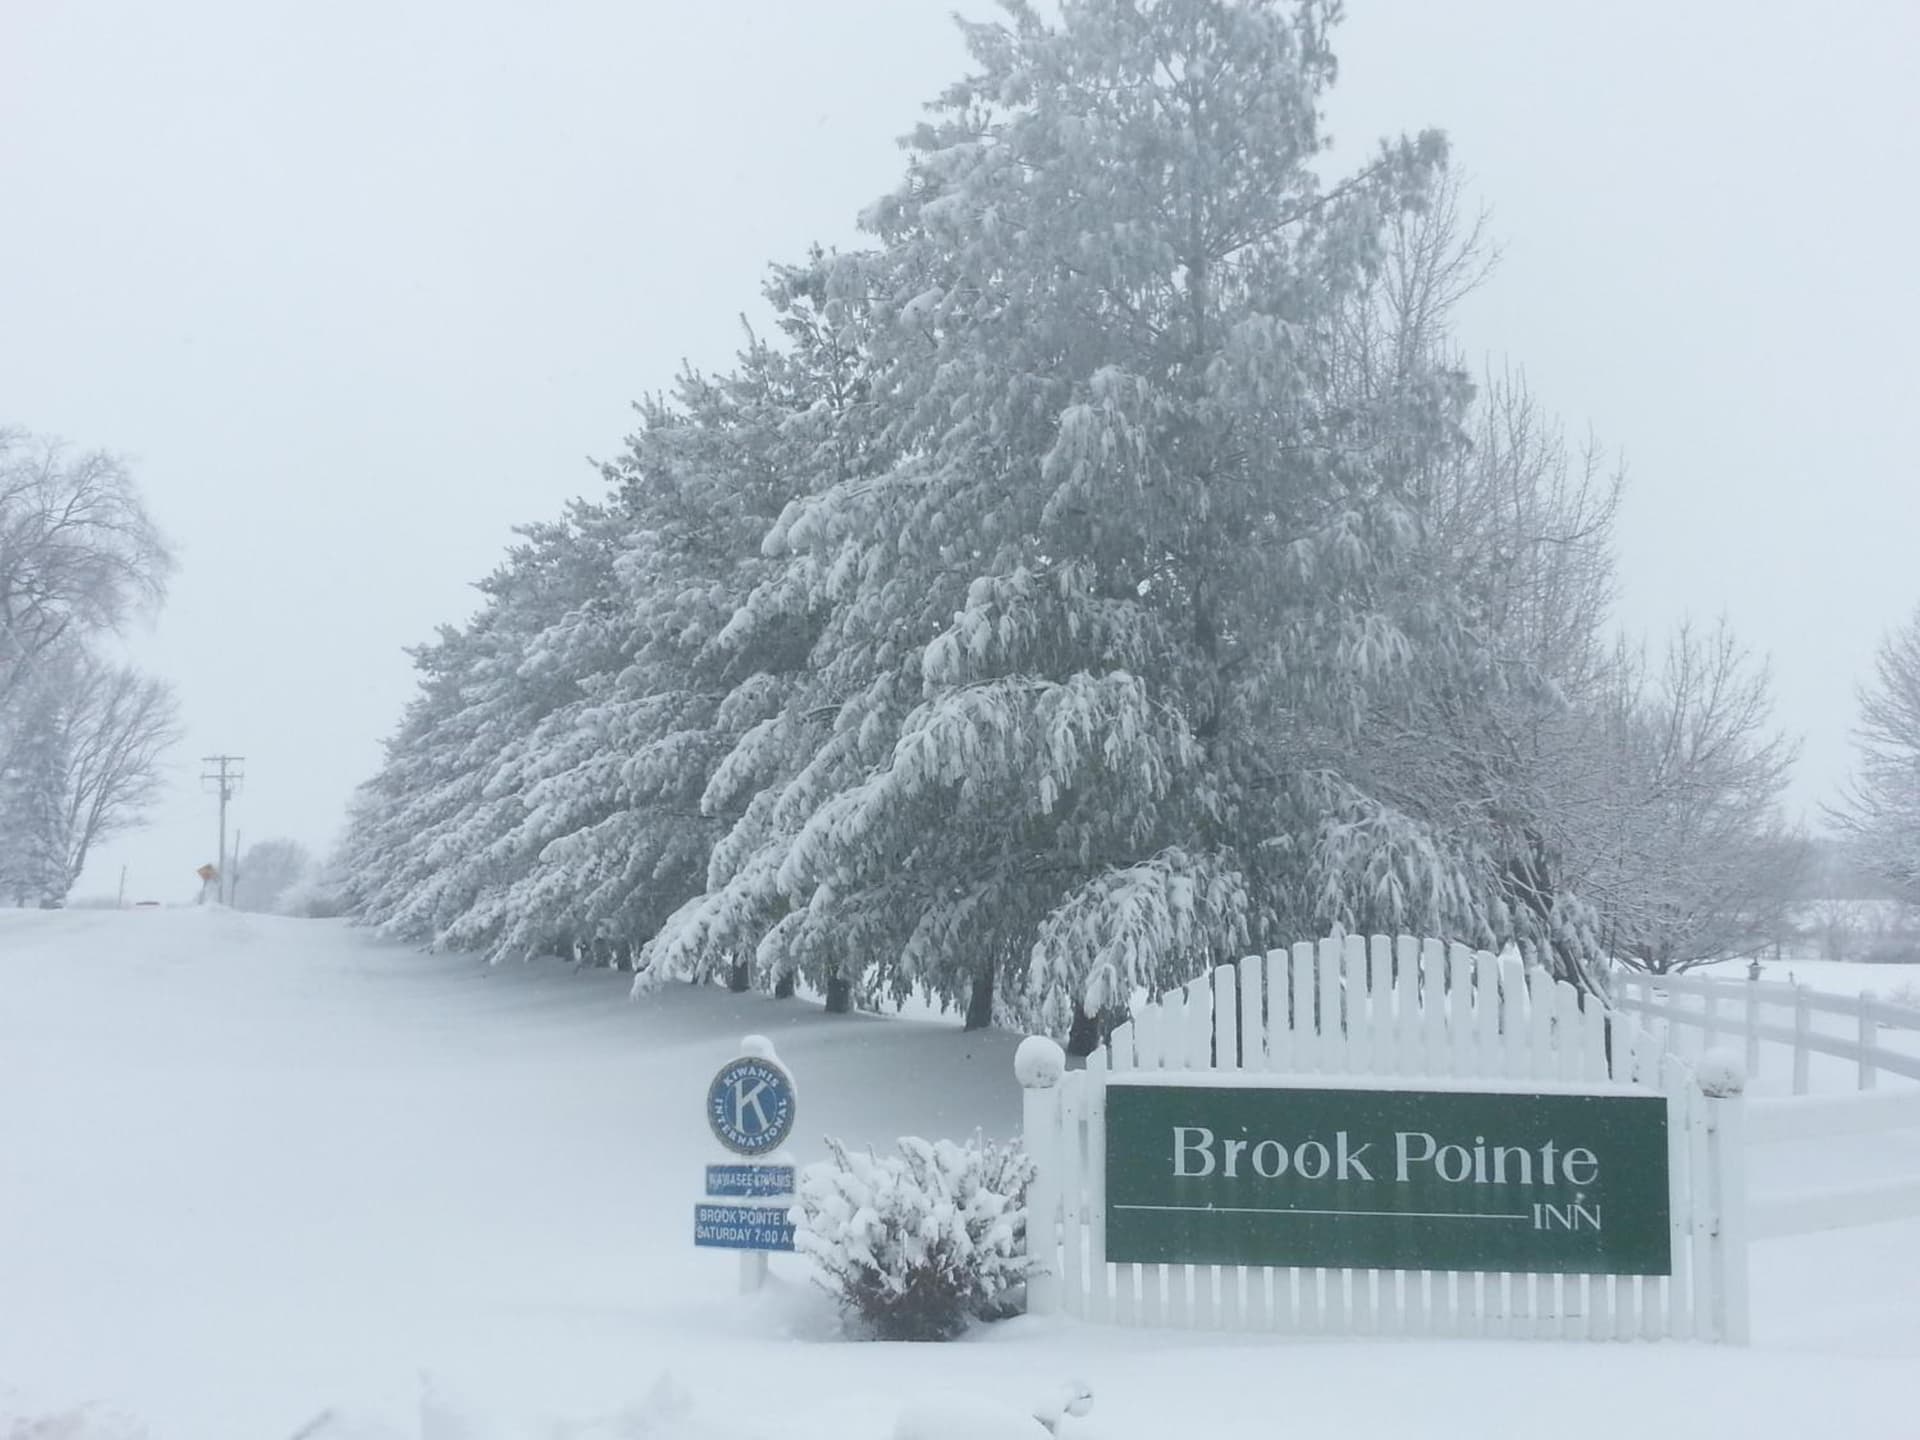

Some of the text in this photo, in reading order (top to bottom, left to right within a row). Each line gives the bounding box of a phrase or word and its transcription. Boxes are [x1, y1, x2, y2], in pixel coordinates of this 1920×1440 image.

[723, 1066, 779, 1087] KIWANIS
[734, 1079, 769, 1134] K
[714, 1097, 787, 1147] INTERNATIONAL
[1172, 1126, 1599, 1185] Brook Pointe
[700, 1208, 737, 1224] BROOK
[739, 1210, 780, 1226] POINTE
[1532, 1202, 1602, 1231] INN
[696, 1225, 752, 1241] SATURDAY
[755, 1229, 778, 1244] 7:00
